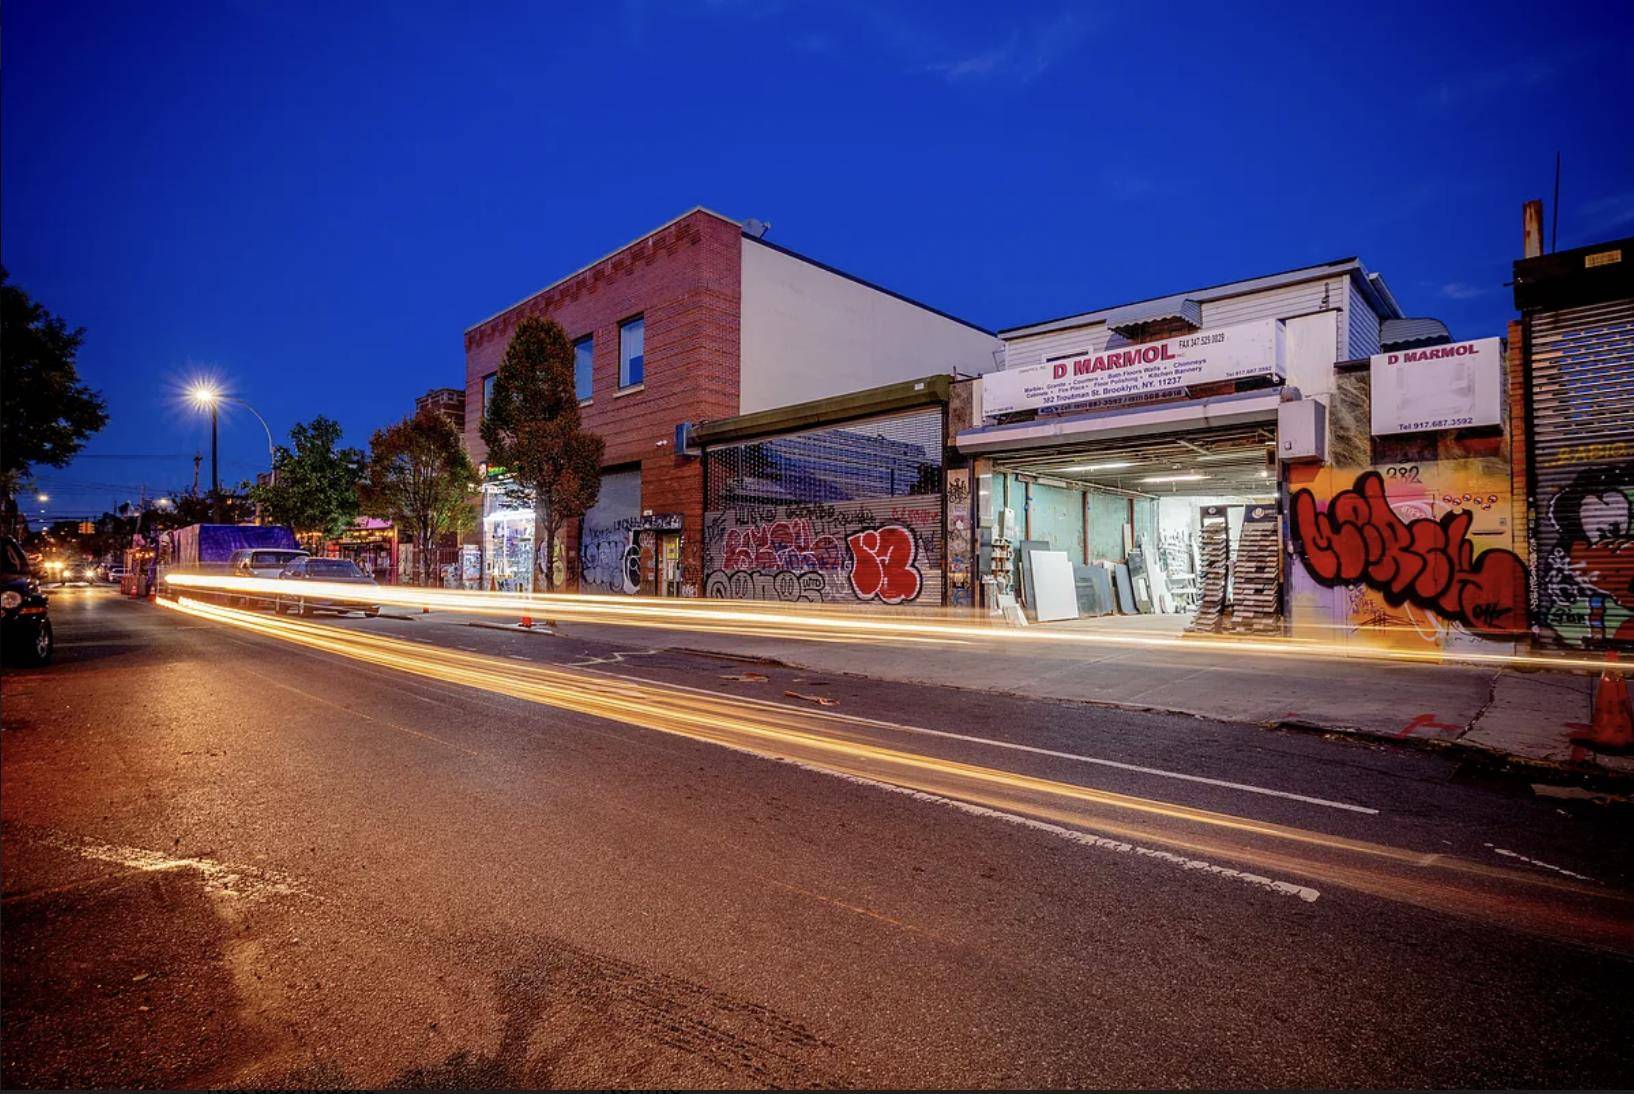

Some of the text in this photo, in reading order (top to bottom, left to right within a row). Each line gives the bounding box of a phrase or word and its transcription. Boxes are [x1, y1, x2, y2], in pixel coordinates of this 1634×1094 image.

[1179, 339, 1190, 349] FAX
[1053, 343, 1176, 380] D MARMOL
[1387, 344, 1480, 365] D MARMOL
[1173, 358, 1206, 369] Chimneys
[1148, 370, 1174, 379] Kitchen
[1056, 391, 1090, 402] Troutman
[1091, 389, 1102, 397] St.
[1103, 384, 1140, 396] Brooklyn,
[1158, 376, 1182, 386] 11237
